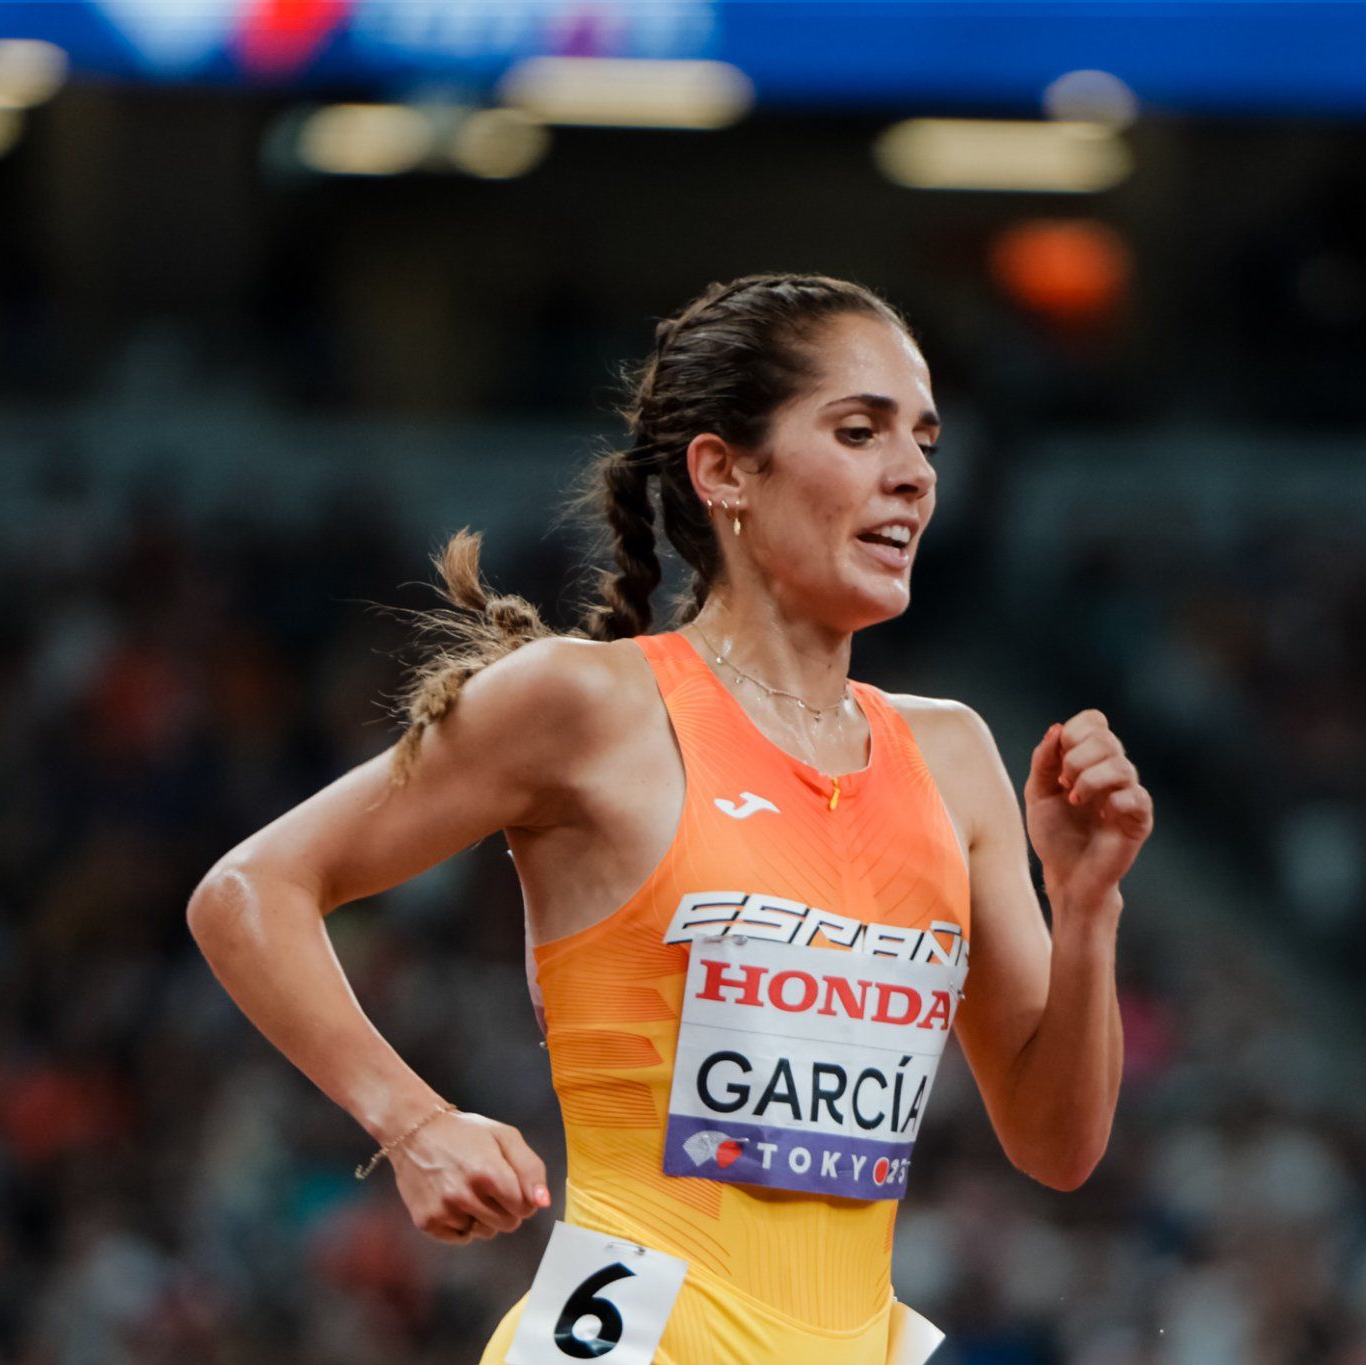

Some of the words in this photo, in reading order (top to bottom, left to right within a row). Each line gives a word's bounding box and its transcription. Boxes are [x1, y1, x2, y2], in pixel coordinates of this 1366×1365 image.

[695, 959, 951, 1031] HONDA
[696, 1050, 928, 1134] GARCÍA
[554, 1261, 638, 1360] 6
